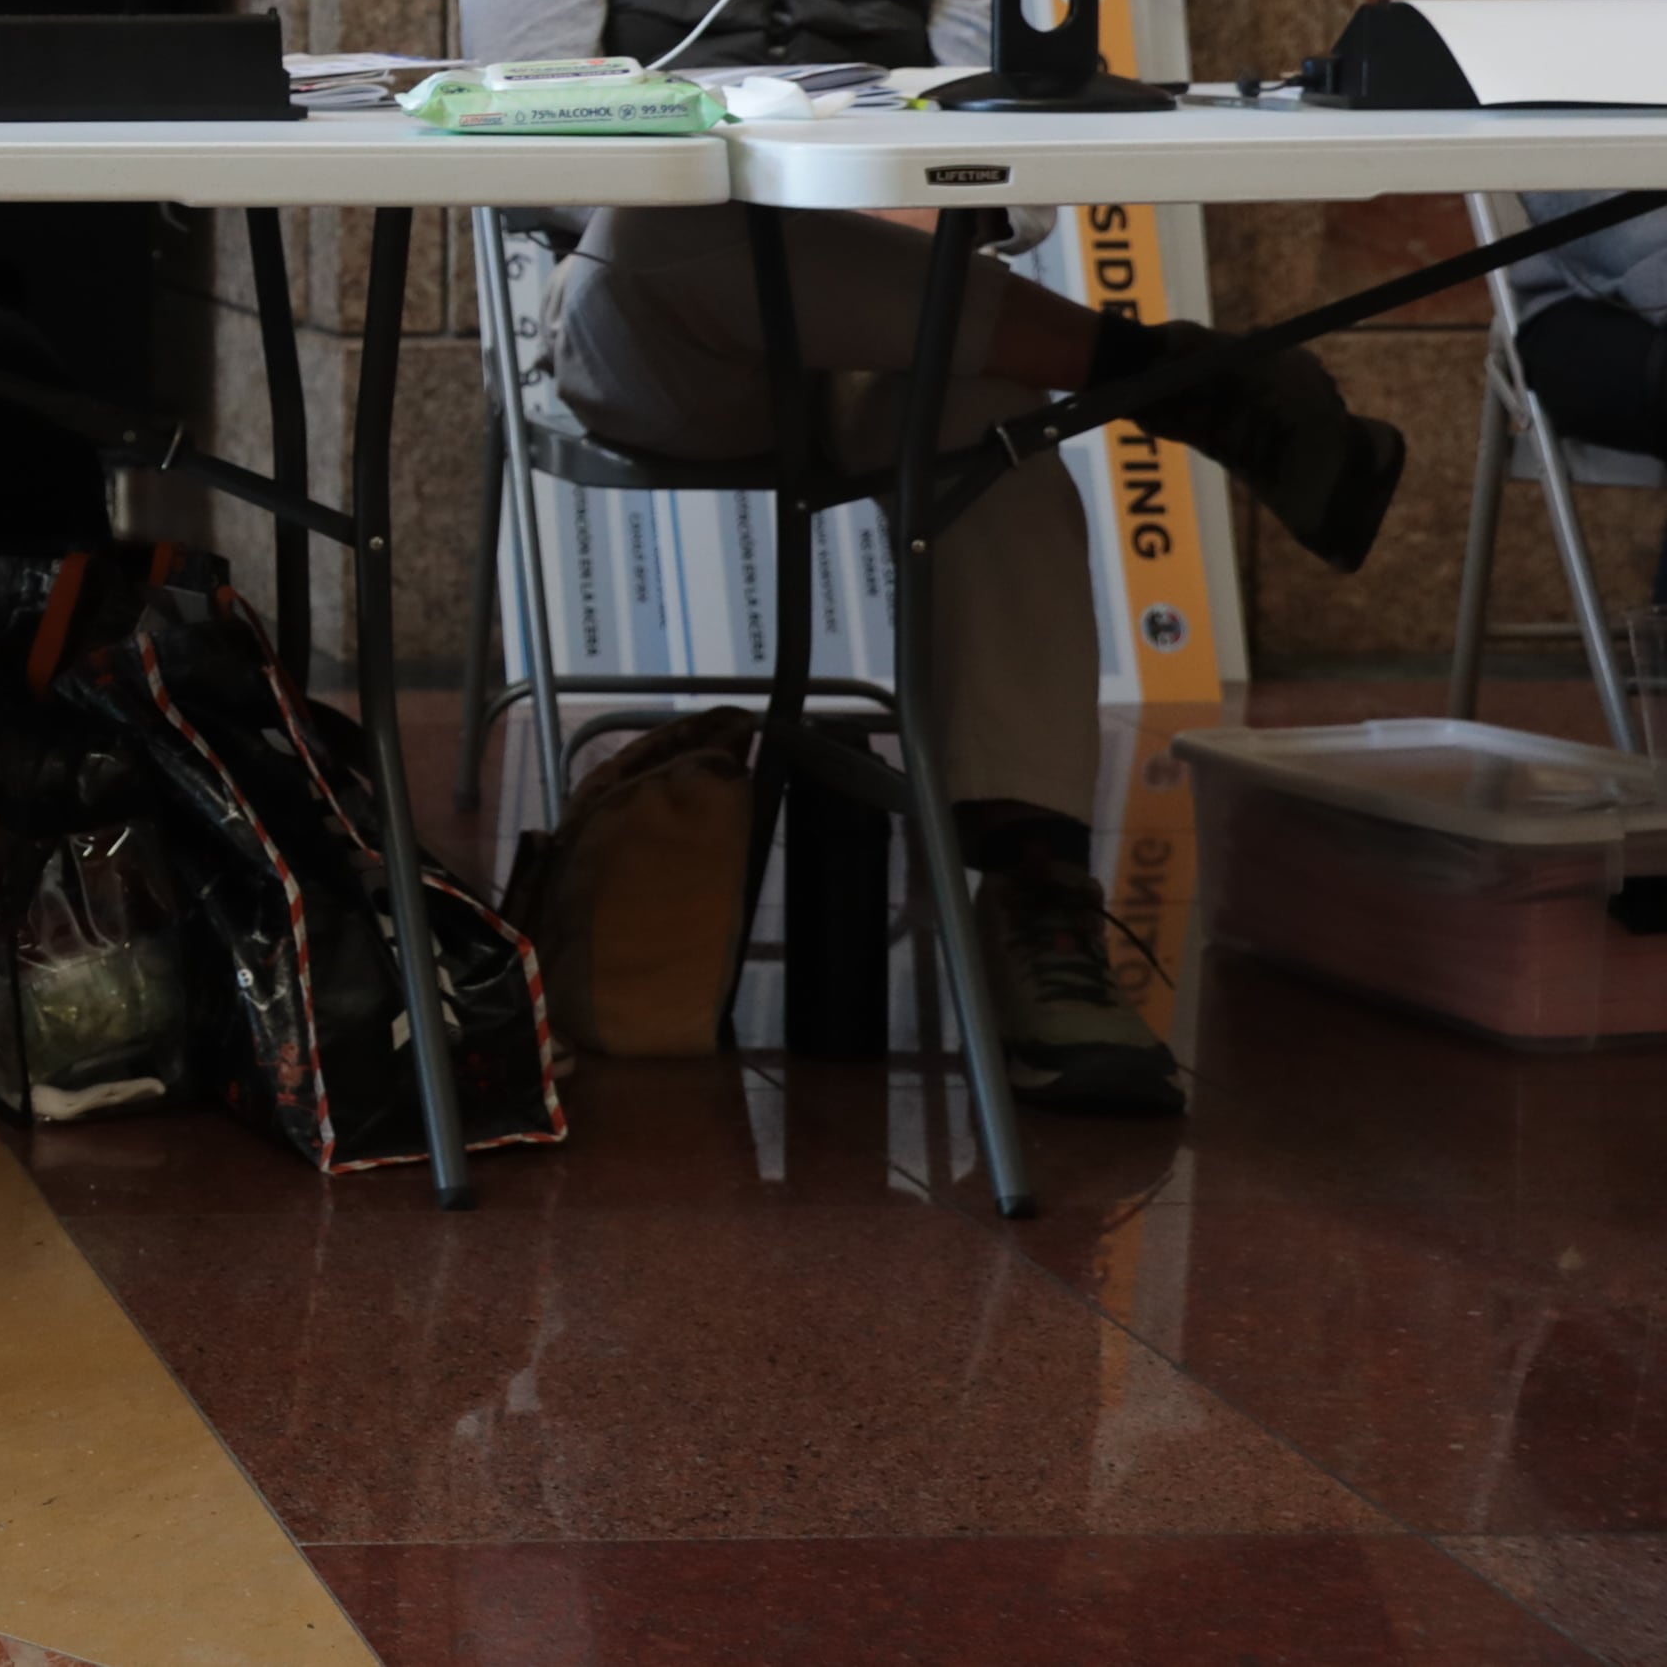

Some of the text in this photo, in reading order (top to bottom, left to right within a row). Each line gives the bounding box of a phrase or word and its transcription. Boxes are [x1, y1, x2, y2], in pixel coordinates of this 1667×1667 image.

[530, 107, 612, 120] 75% ALCOHOL
[641, 104, 688, 116] 99.99%
[935, 170, 1000, 182] LIFETIME
[1118, 434, 1172, 561] TING
